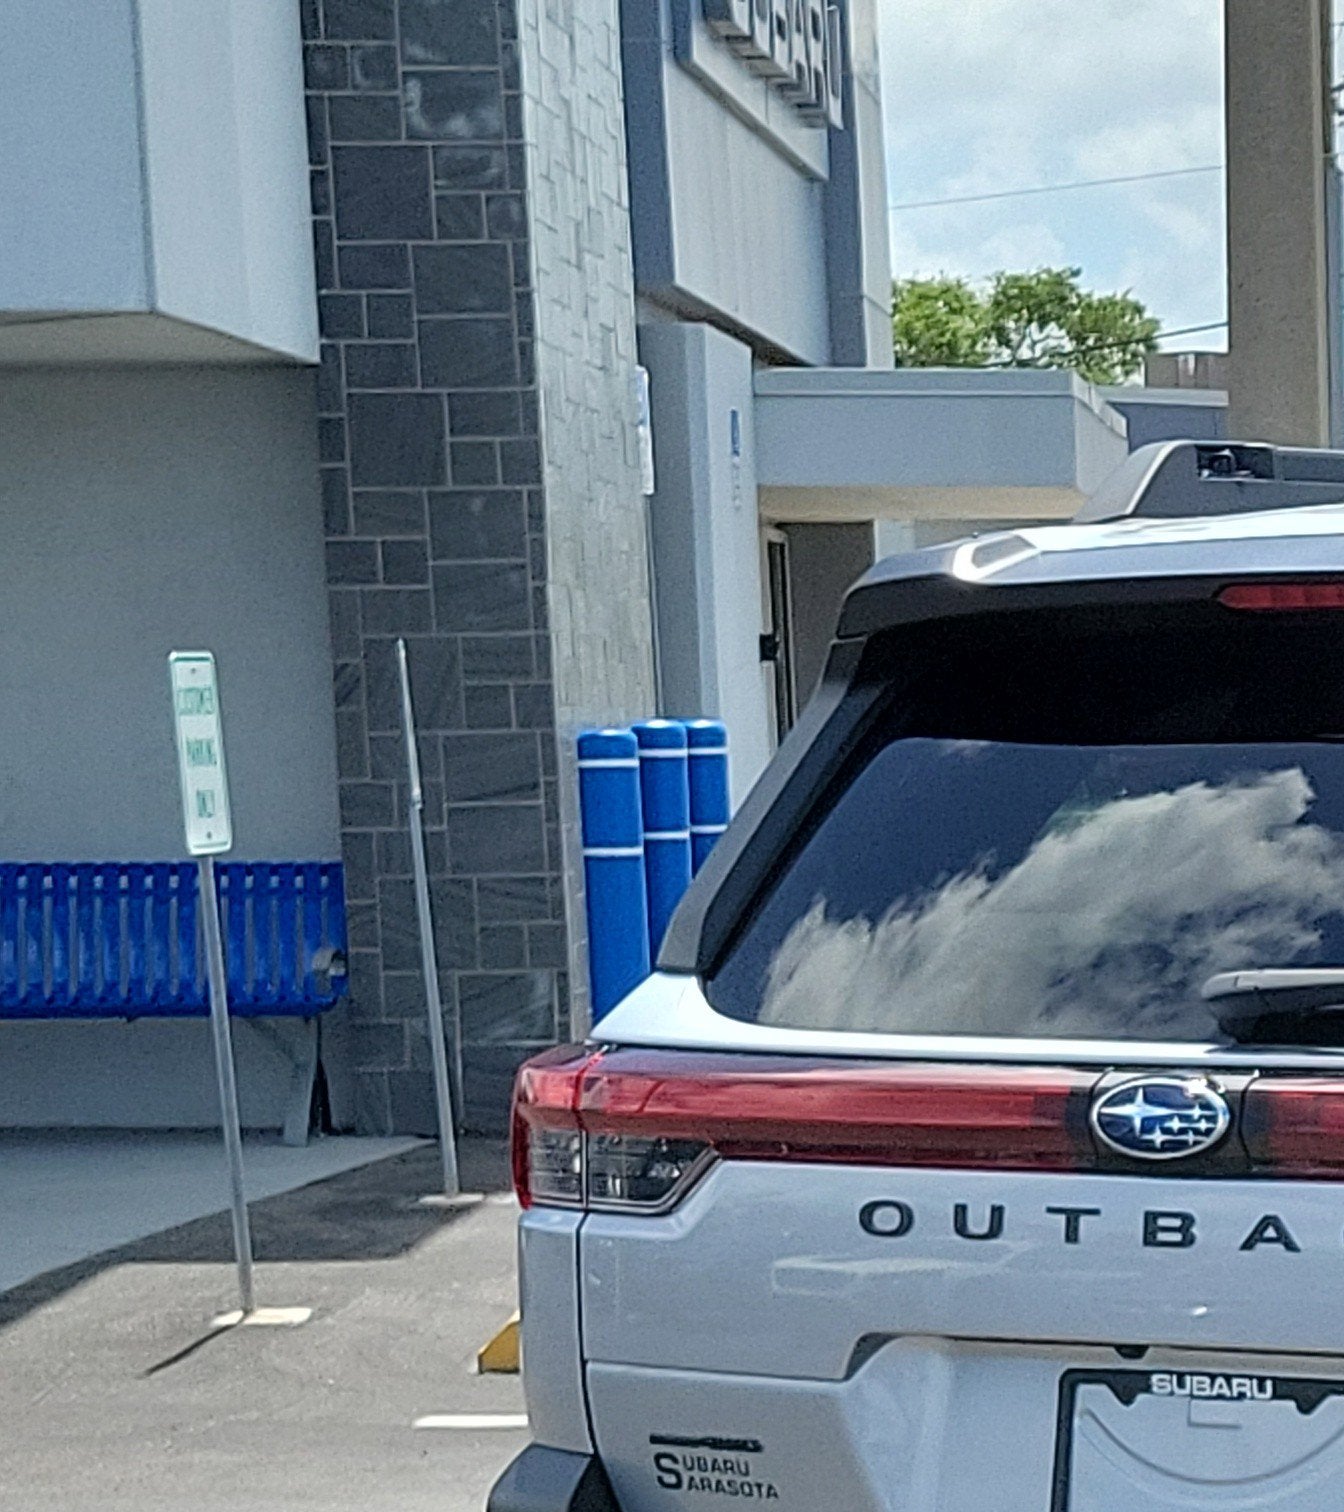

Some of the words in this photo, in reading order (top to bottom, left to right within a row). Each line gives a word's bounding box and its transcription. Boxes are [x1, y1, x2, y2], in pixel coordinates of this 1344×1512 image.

[1149, 1372, 1275, 1401] SUBARU
[653, 1451, 751, 1483] SUBARU
[655, 1464, 779, 1499] SARASOTA
